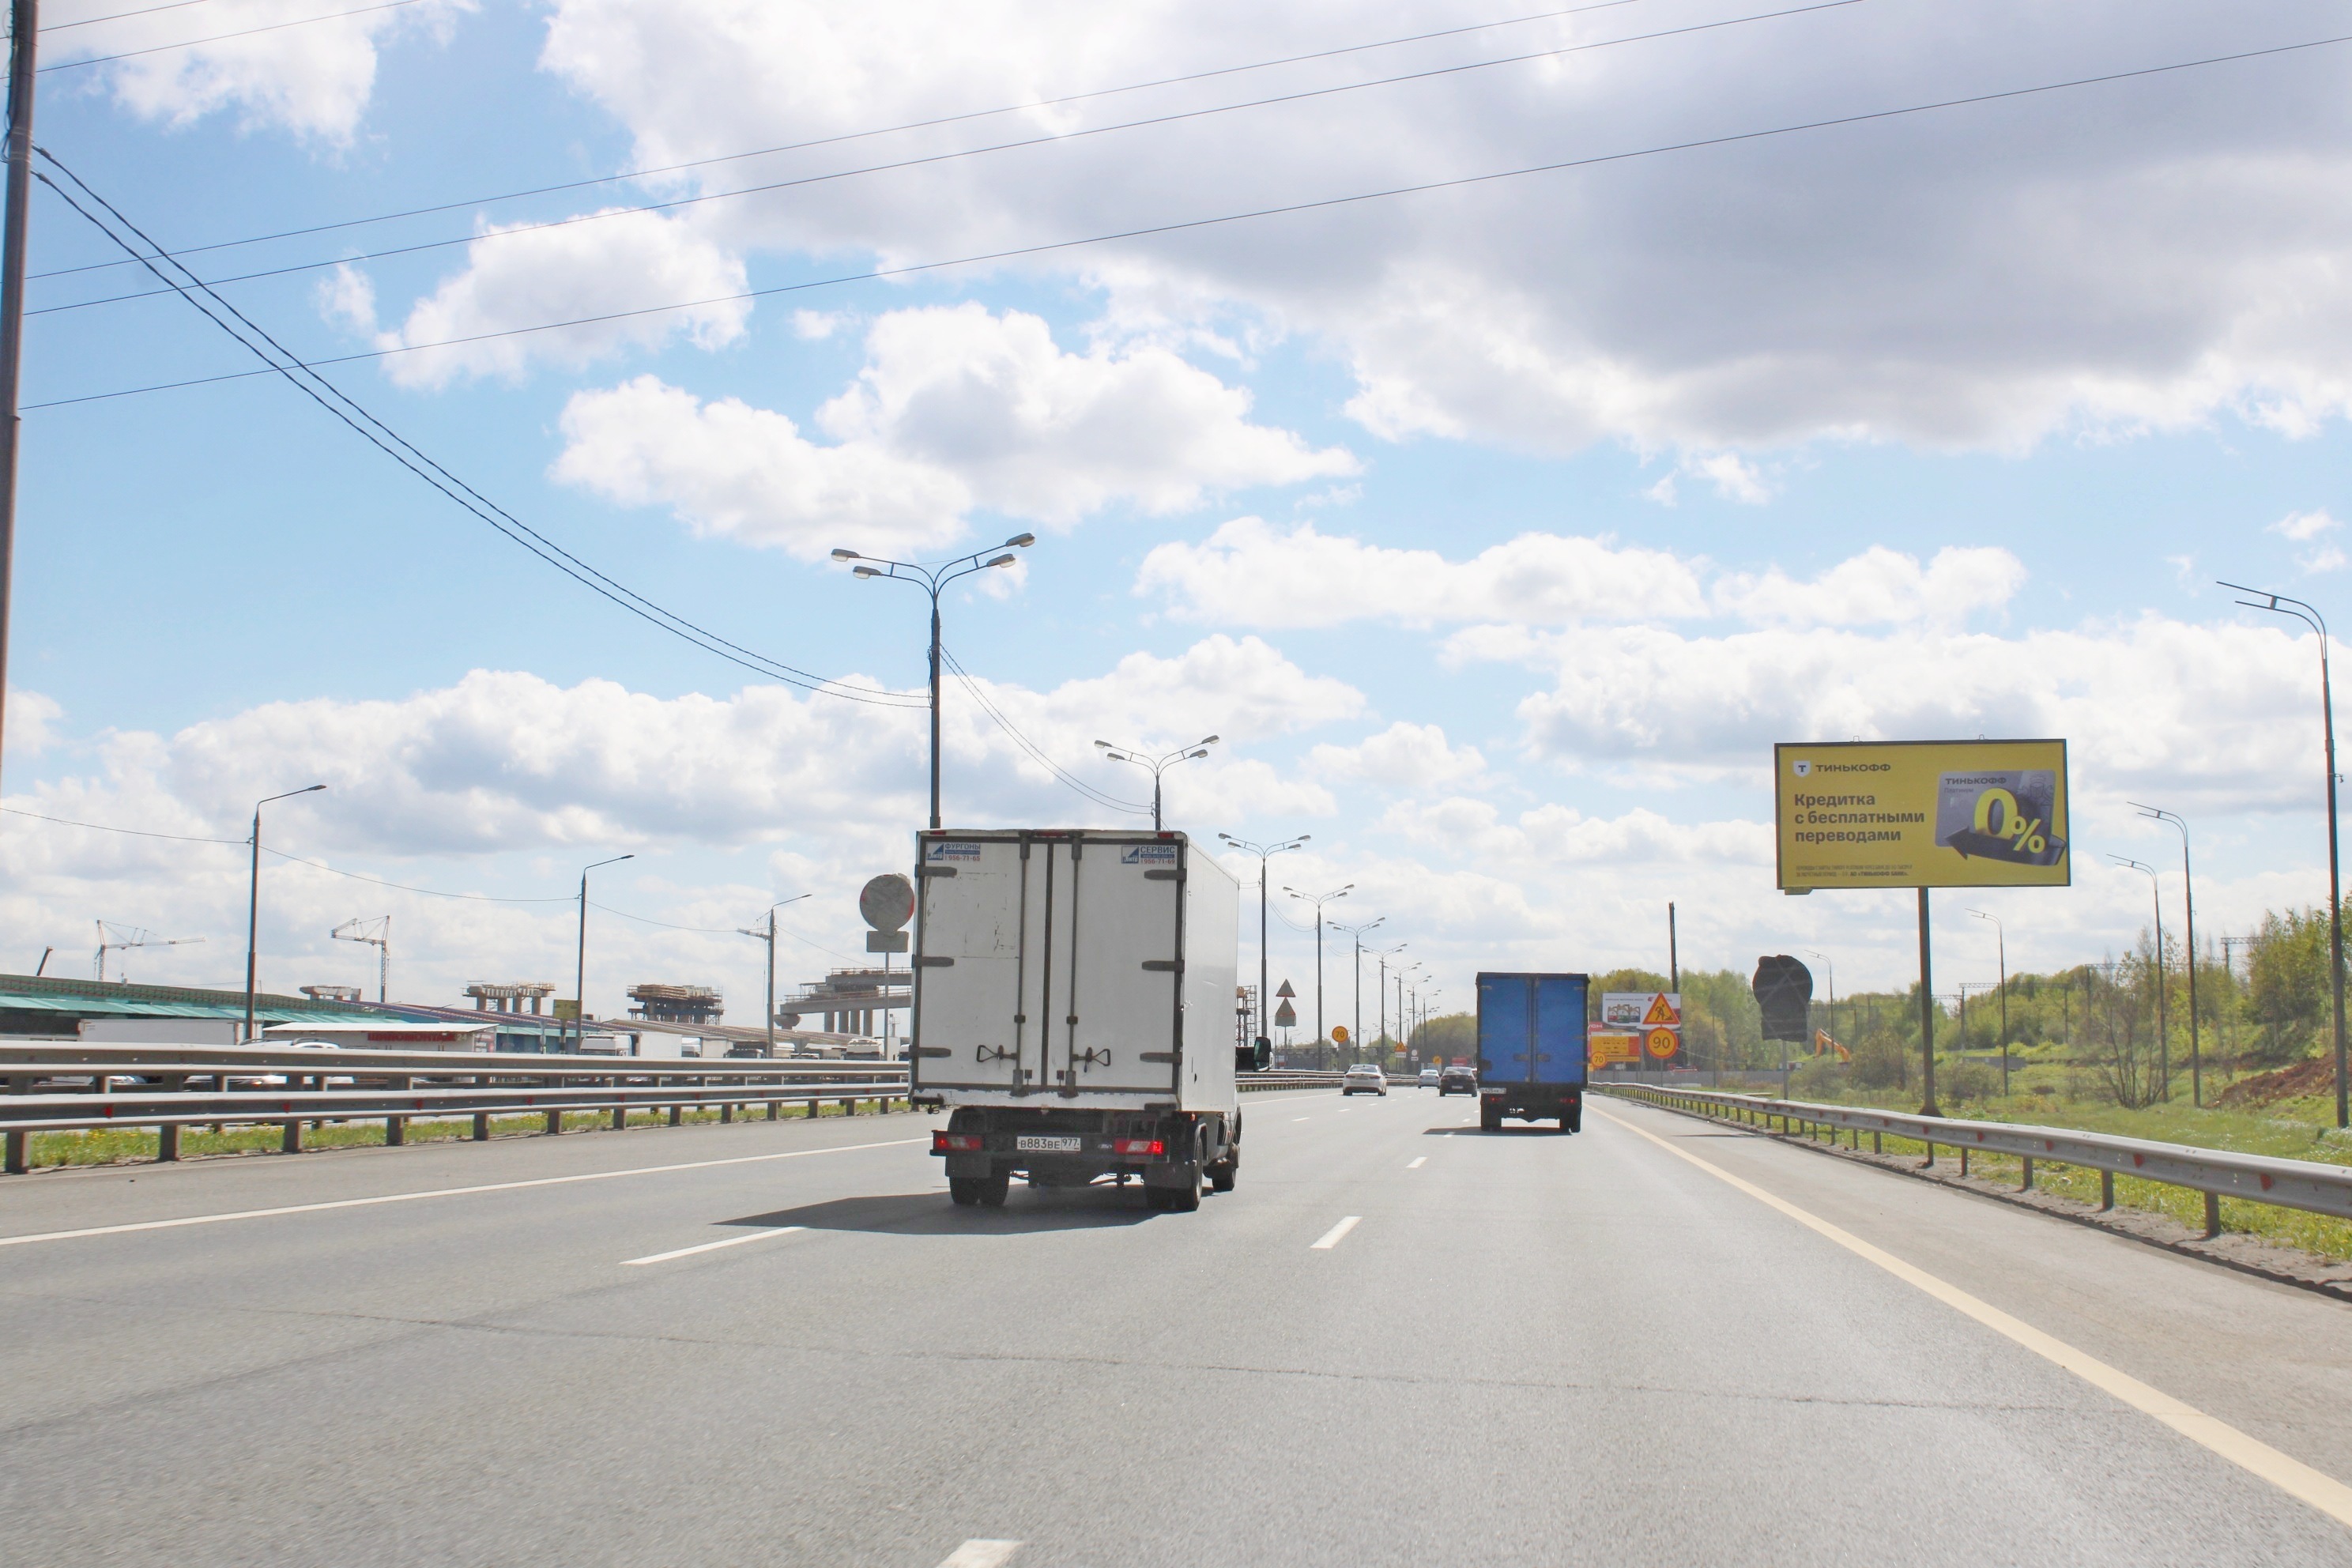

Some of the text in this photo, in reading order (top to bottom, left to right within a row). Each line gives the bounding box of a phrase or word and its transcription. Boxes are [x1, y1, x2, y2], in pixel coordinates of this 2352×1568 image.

[1816, 763, 1890, 772] ТИНЬКОФФ
[1795, 793, 1875, 808] Кредитка
[1795, 810, 1924, 824] с бесплатными
[1973, 787, 2045, 854] 0%
[1795, 829, 1901, 844] переводами
[1653, 1036, 1671, 1049] 90
[1020, 1138, 1077, 1149] В883ВЕ 977
